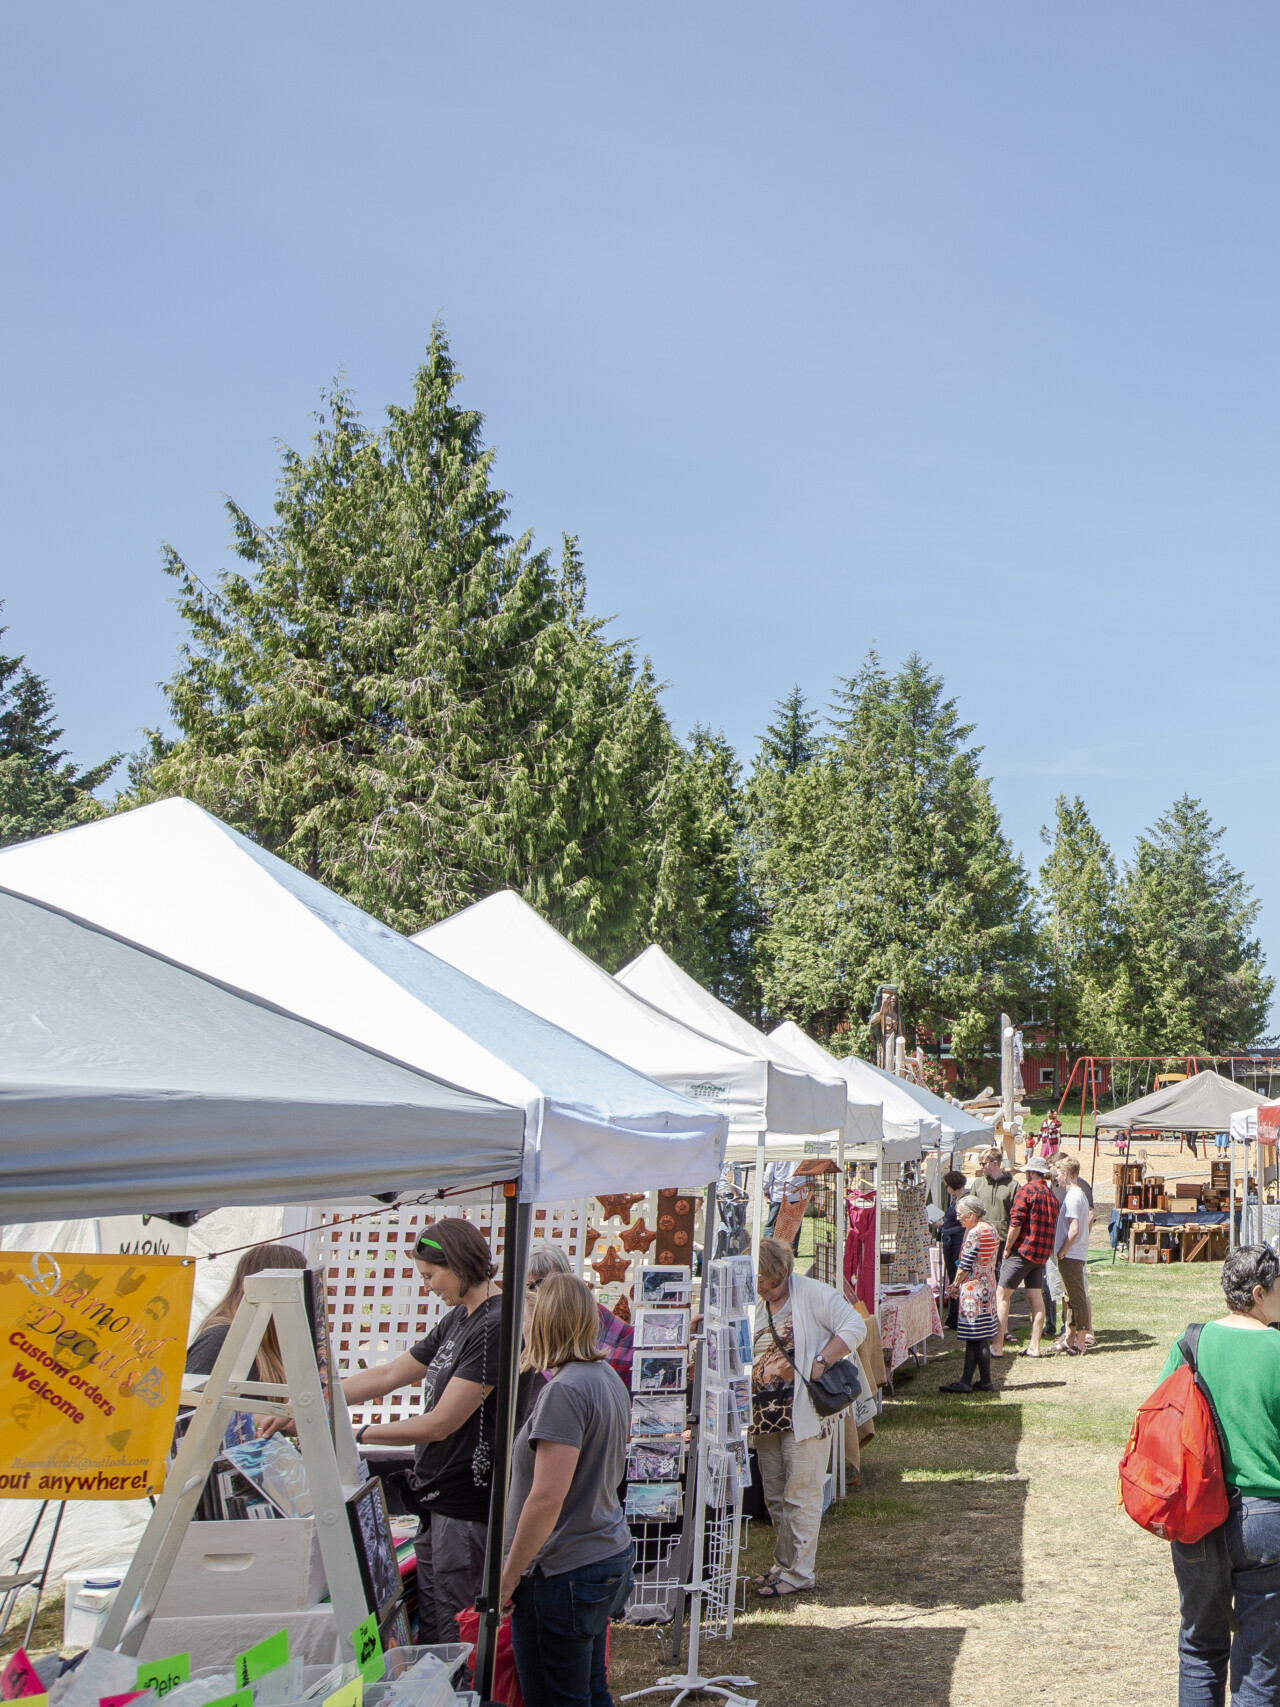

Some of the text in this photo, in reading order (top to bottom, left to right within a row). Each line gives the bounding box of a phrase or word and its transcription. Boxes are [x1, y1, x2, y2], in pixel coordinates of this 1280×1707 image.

[16, 1252, 178, 1360] Diamond
[26, 1305, 142, 1389] Decals
[9, 1331, 116, 1417] Custom orders
[11, 1362, 85, 1424] Welcome
[38, 1470, 149, 1493] anywhere!
